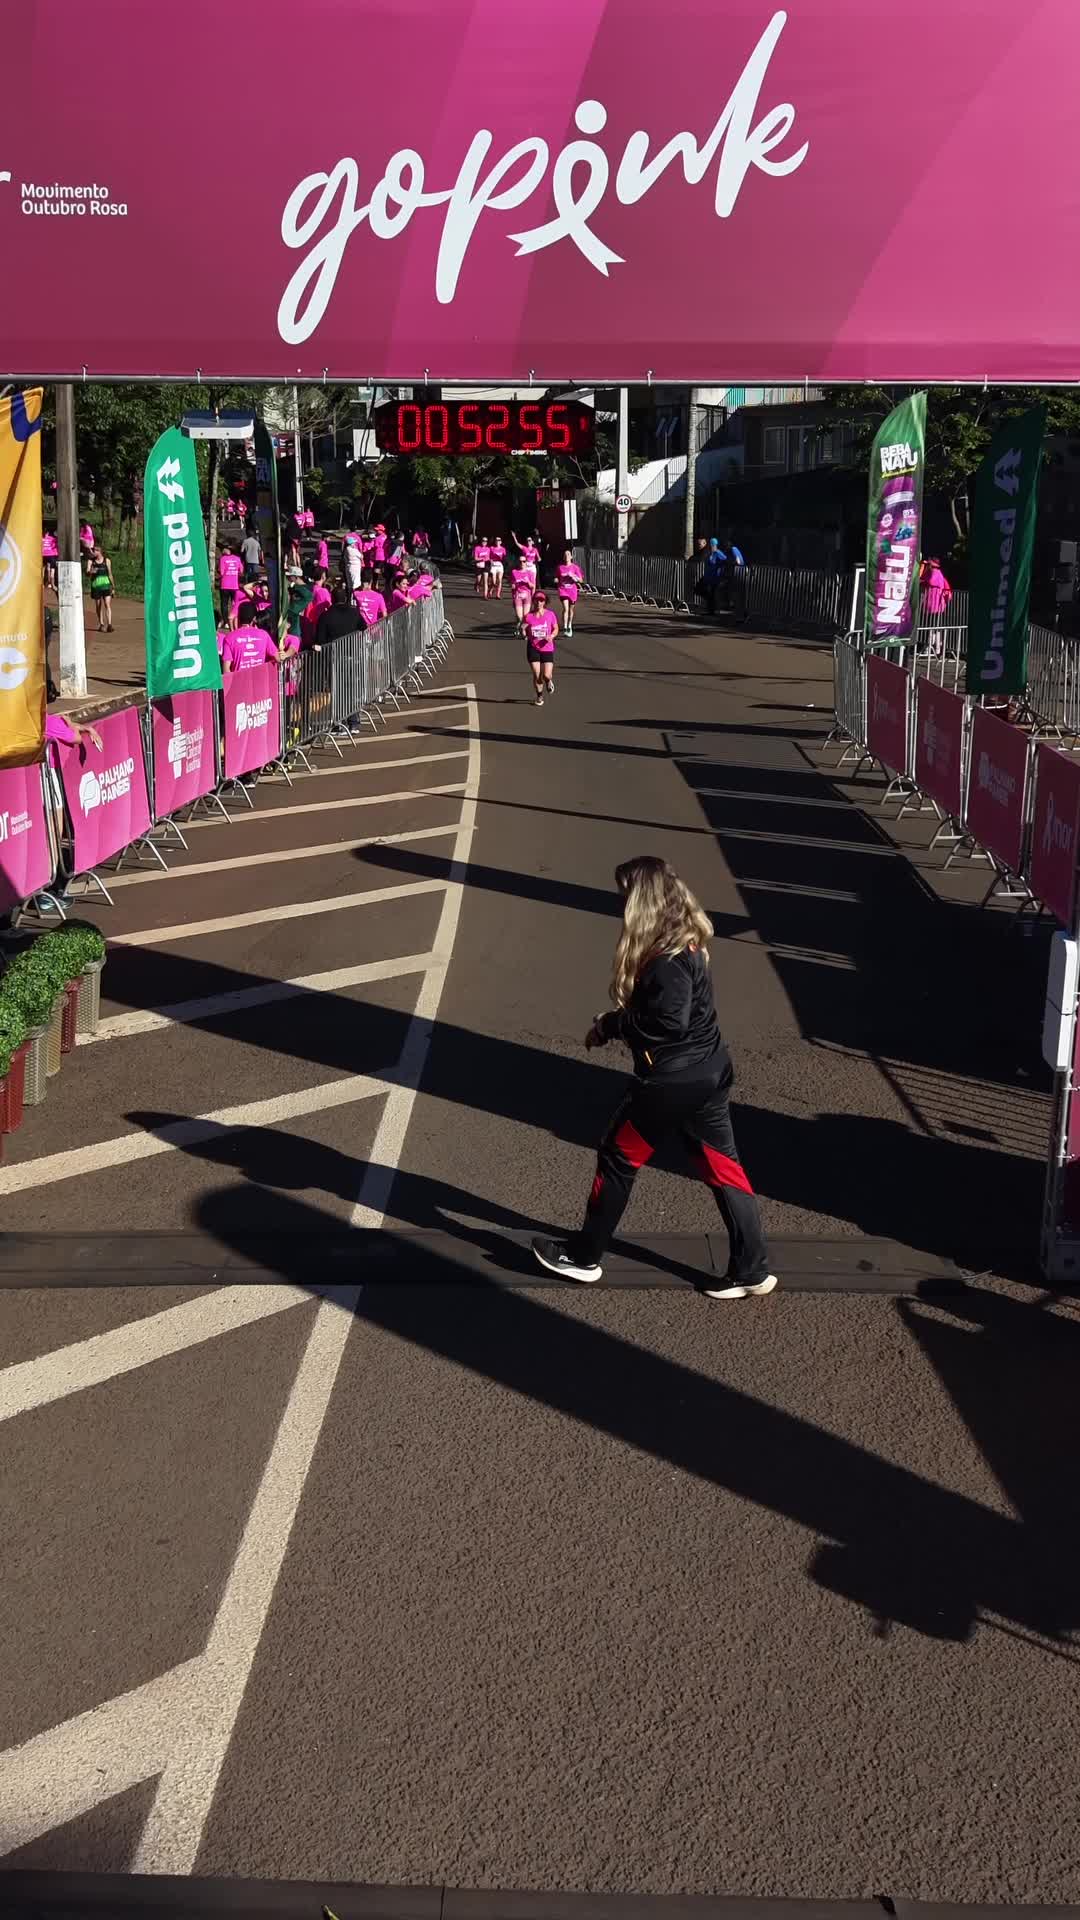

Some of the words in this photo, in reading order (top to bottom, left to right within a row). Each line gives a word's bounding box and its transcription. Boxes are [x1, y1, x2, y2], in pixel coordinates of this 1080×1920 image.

[21, 183, 109, 198] Movimento
[22, 199, 86, 215] Outubro
[90, 200, 128, 215] Rosa
[398, 405, 448, 448] 00
[458, 405, 510, 448] 52
[519, 405, 570, 448] 55
[880, 442, 911, 460] BEBA
[881, 451, 918, 472] NATU
[617, 498, 630, 506] 40
[162, 513, 203, 679] Unimed
[981, 509, 1017, 680] Unimed
[98, 757, 135, 789] PALHANO
